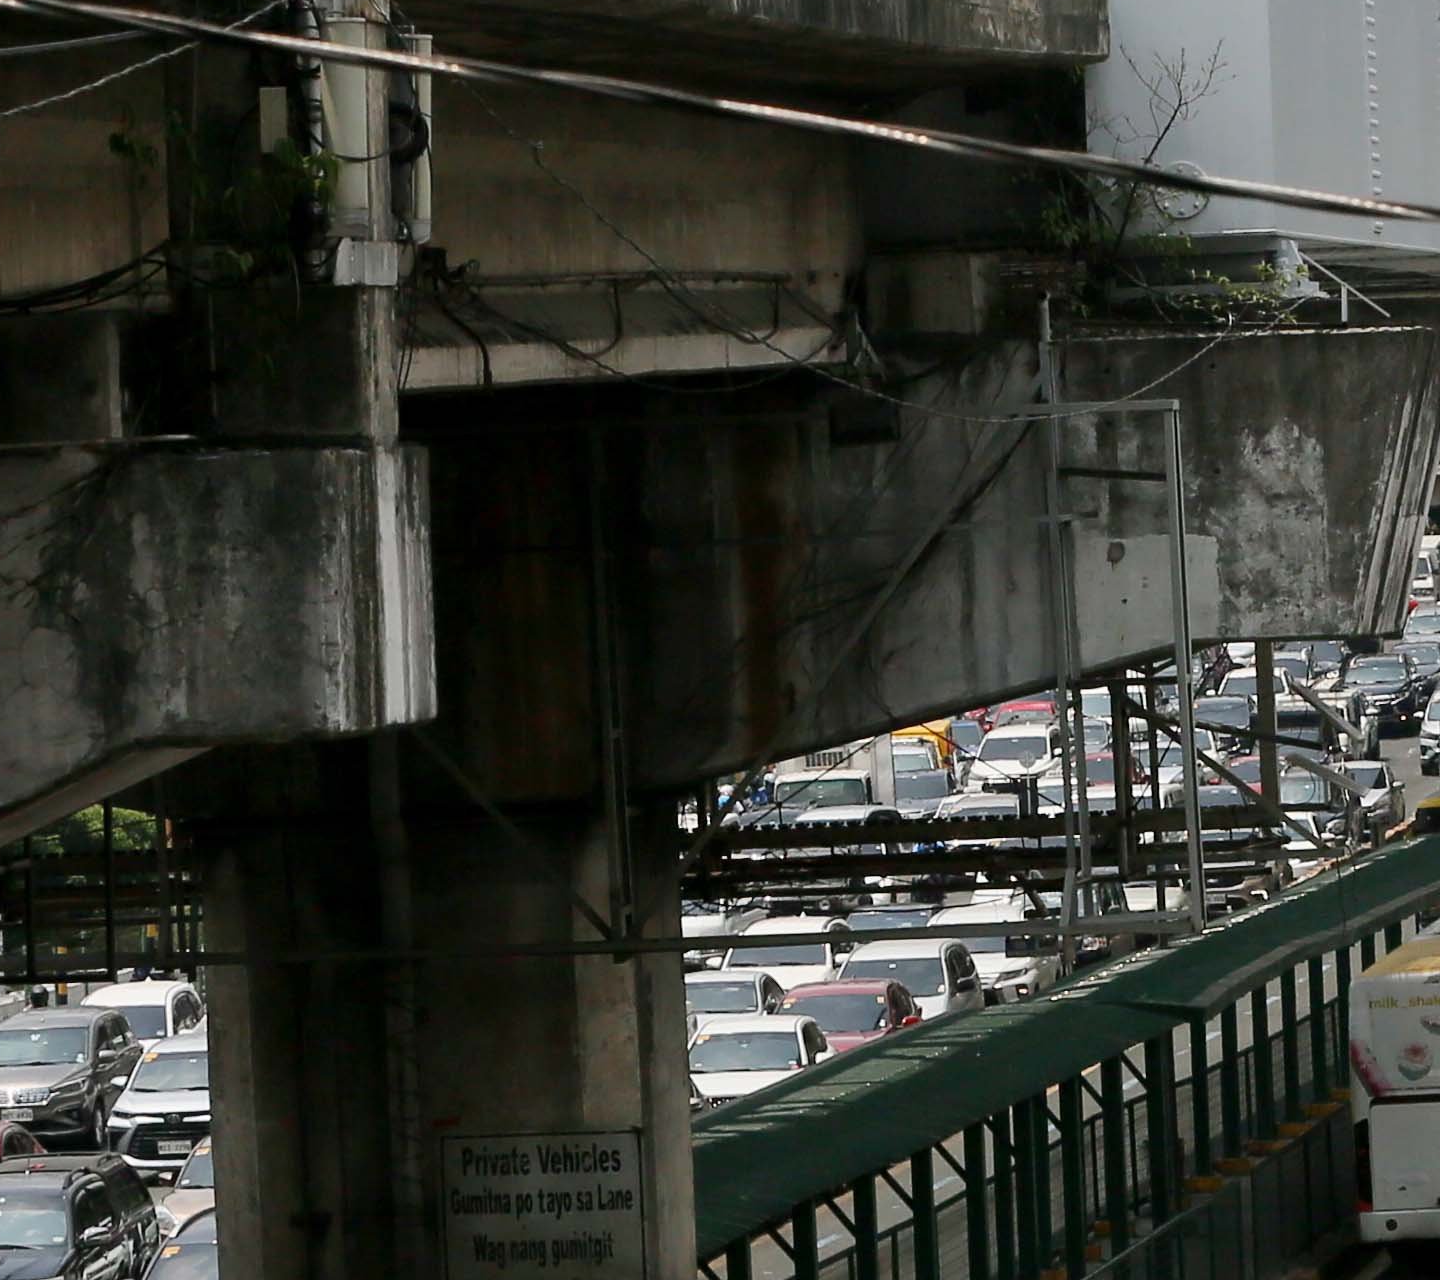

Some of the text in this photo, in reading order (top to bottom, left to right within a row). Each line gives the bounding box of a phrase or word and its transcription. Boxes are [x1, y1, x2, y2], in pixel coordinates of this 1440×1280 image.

[462, 1143, 622, 1177] Private Vehicles
[516, 1195, 534, 1221] po
[538, 1188, 573, 1221] tayo
[576, 1194, 595, 1212] sa
[597, 1185, 635, 1211] Lane
[473, 1235, 507, 1270] Wag
[510, 1238, 547, 1265] nang
